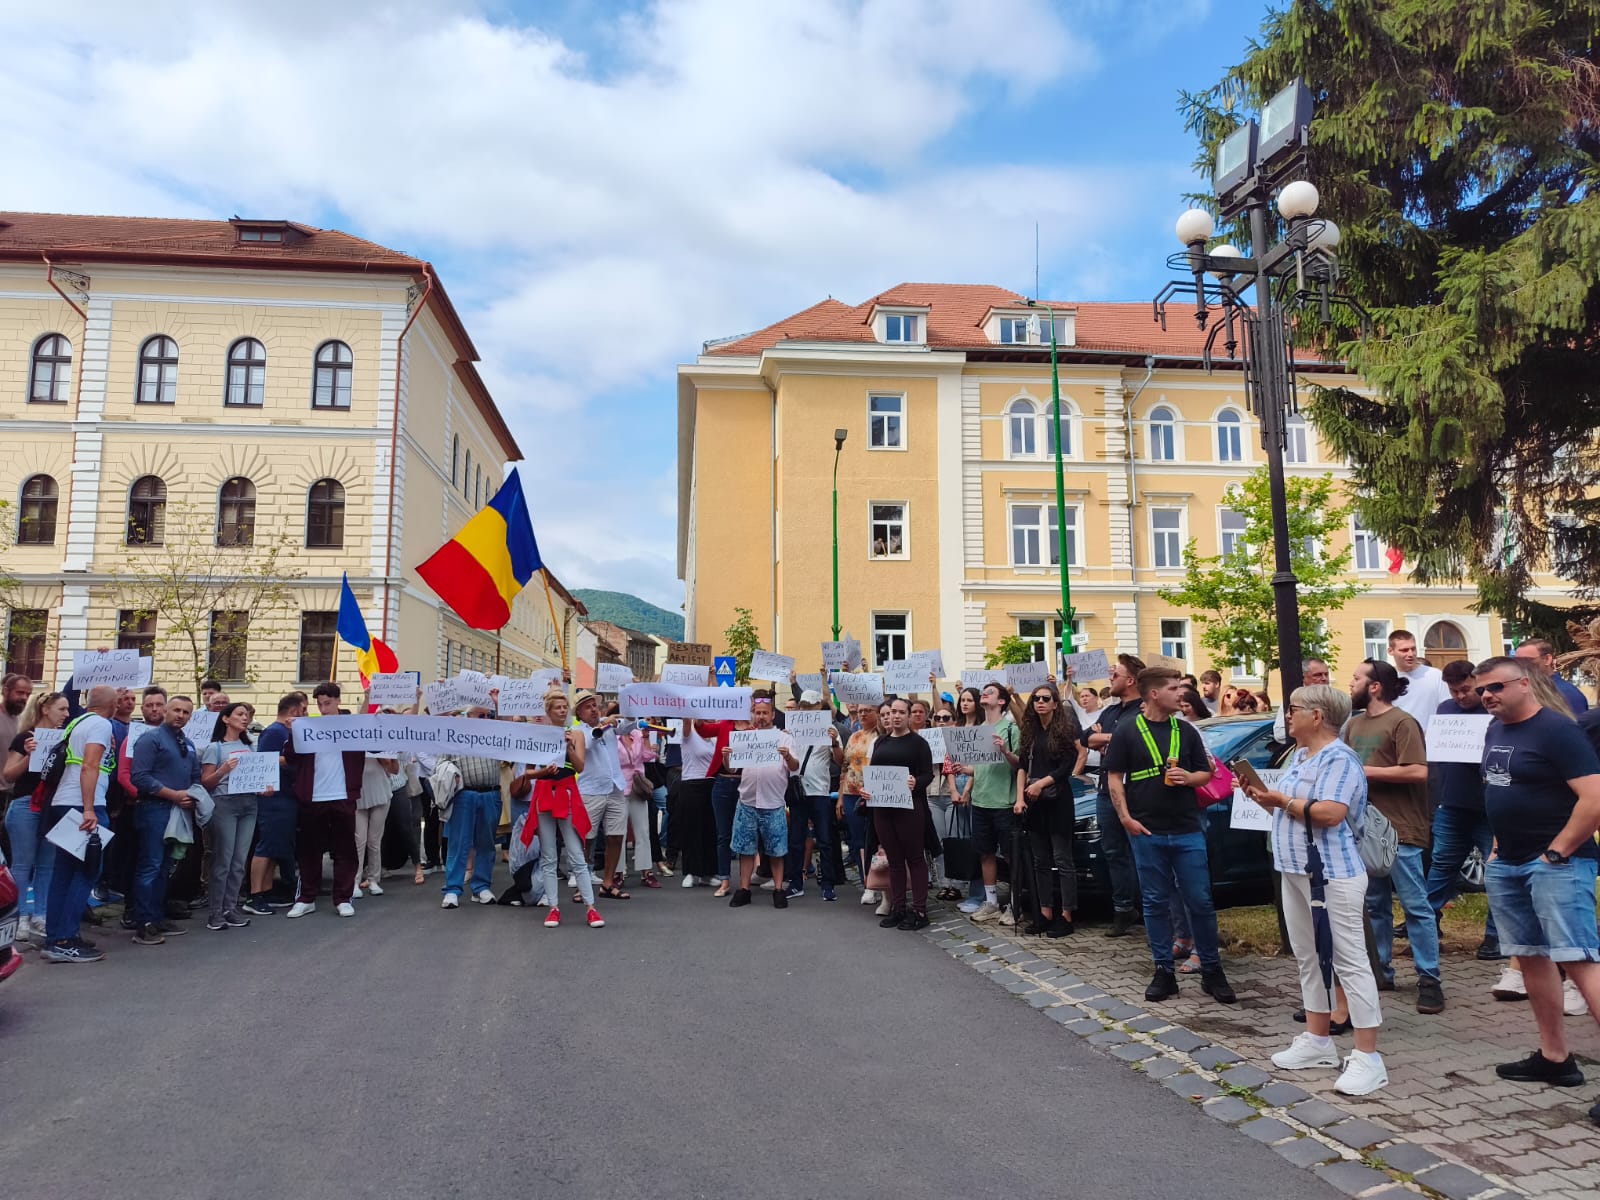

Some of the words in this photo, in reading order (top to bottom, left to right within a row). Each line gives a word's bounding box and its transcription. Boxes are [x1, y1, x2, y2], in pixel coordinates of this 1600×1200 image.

[670, 643, 710, 652] RESPECT
[83, 652, 132, 664] DIALOG
[93, 665, 112, 673] NU
[503, 681, 533, 691] LEGEA
[627, 695, 649, 707] Nu
[690, 696, 743, 709] cultura!
[303, 725, 382, 743] Respectați
[388, 726, 441, 742] cultura!
[447, 728, 511, 750] Respectați
[515, 737, 563, 754] măsura!
[950, 729, 984, 742] DIALOG
[1233, 809, 1260, 820] CARE
